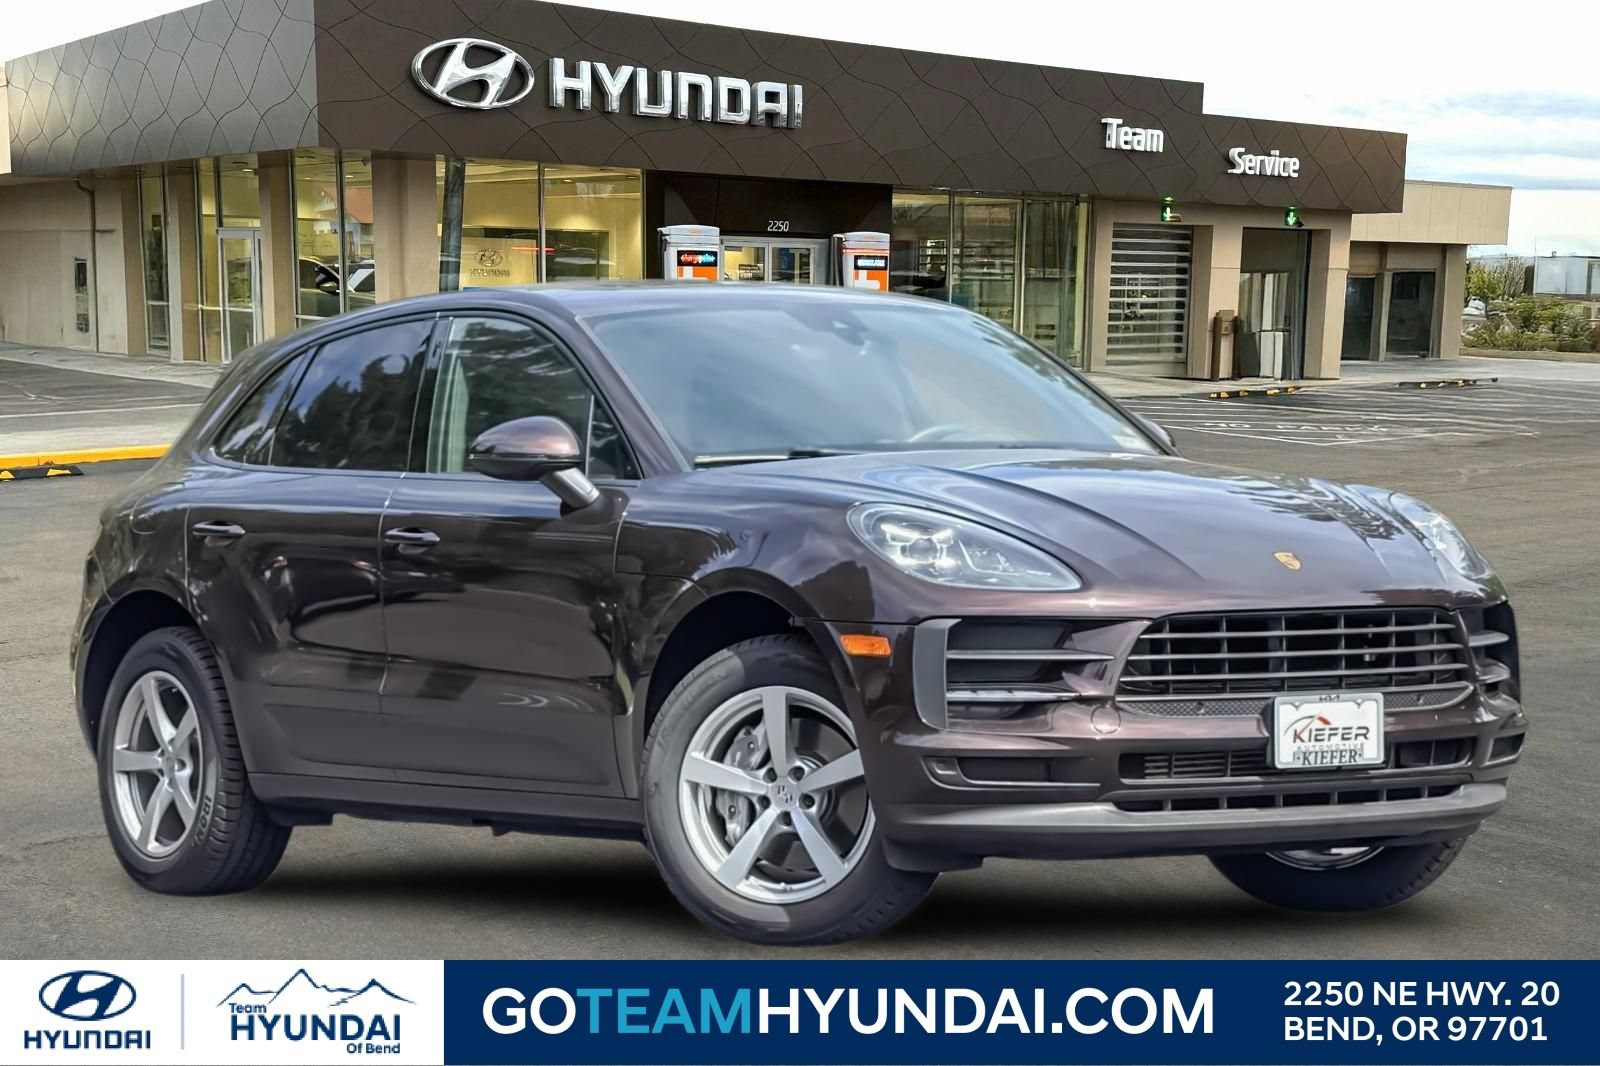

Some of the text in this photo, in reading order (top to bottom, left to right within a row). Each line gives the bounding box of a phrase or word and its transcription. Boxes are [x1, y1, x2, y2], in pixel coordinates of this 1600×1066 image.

[548, 57, 803, 129] HYUNDAI
[1101, 117, 1164, 152] Team
[1227, 147, 1300, 178] Service
[767, 220, 790, 232] 2250
[1293, 724, 1371, 744] KIEFER
[1301, 749, 1358, 766] KIEFER
